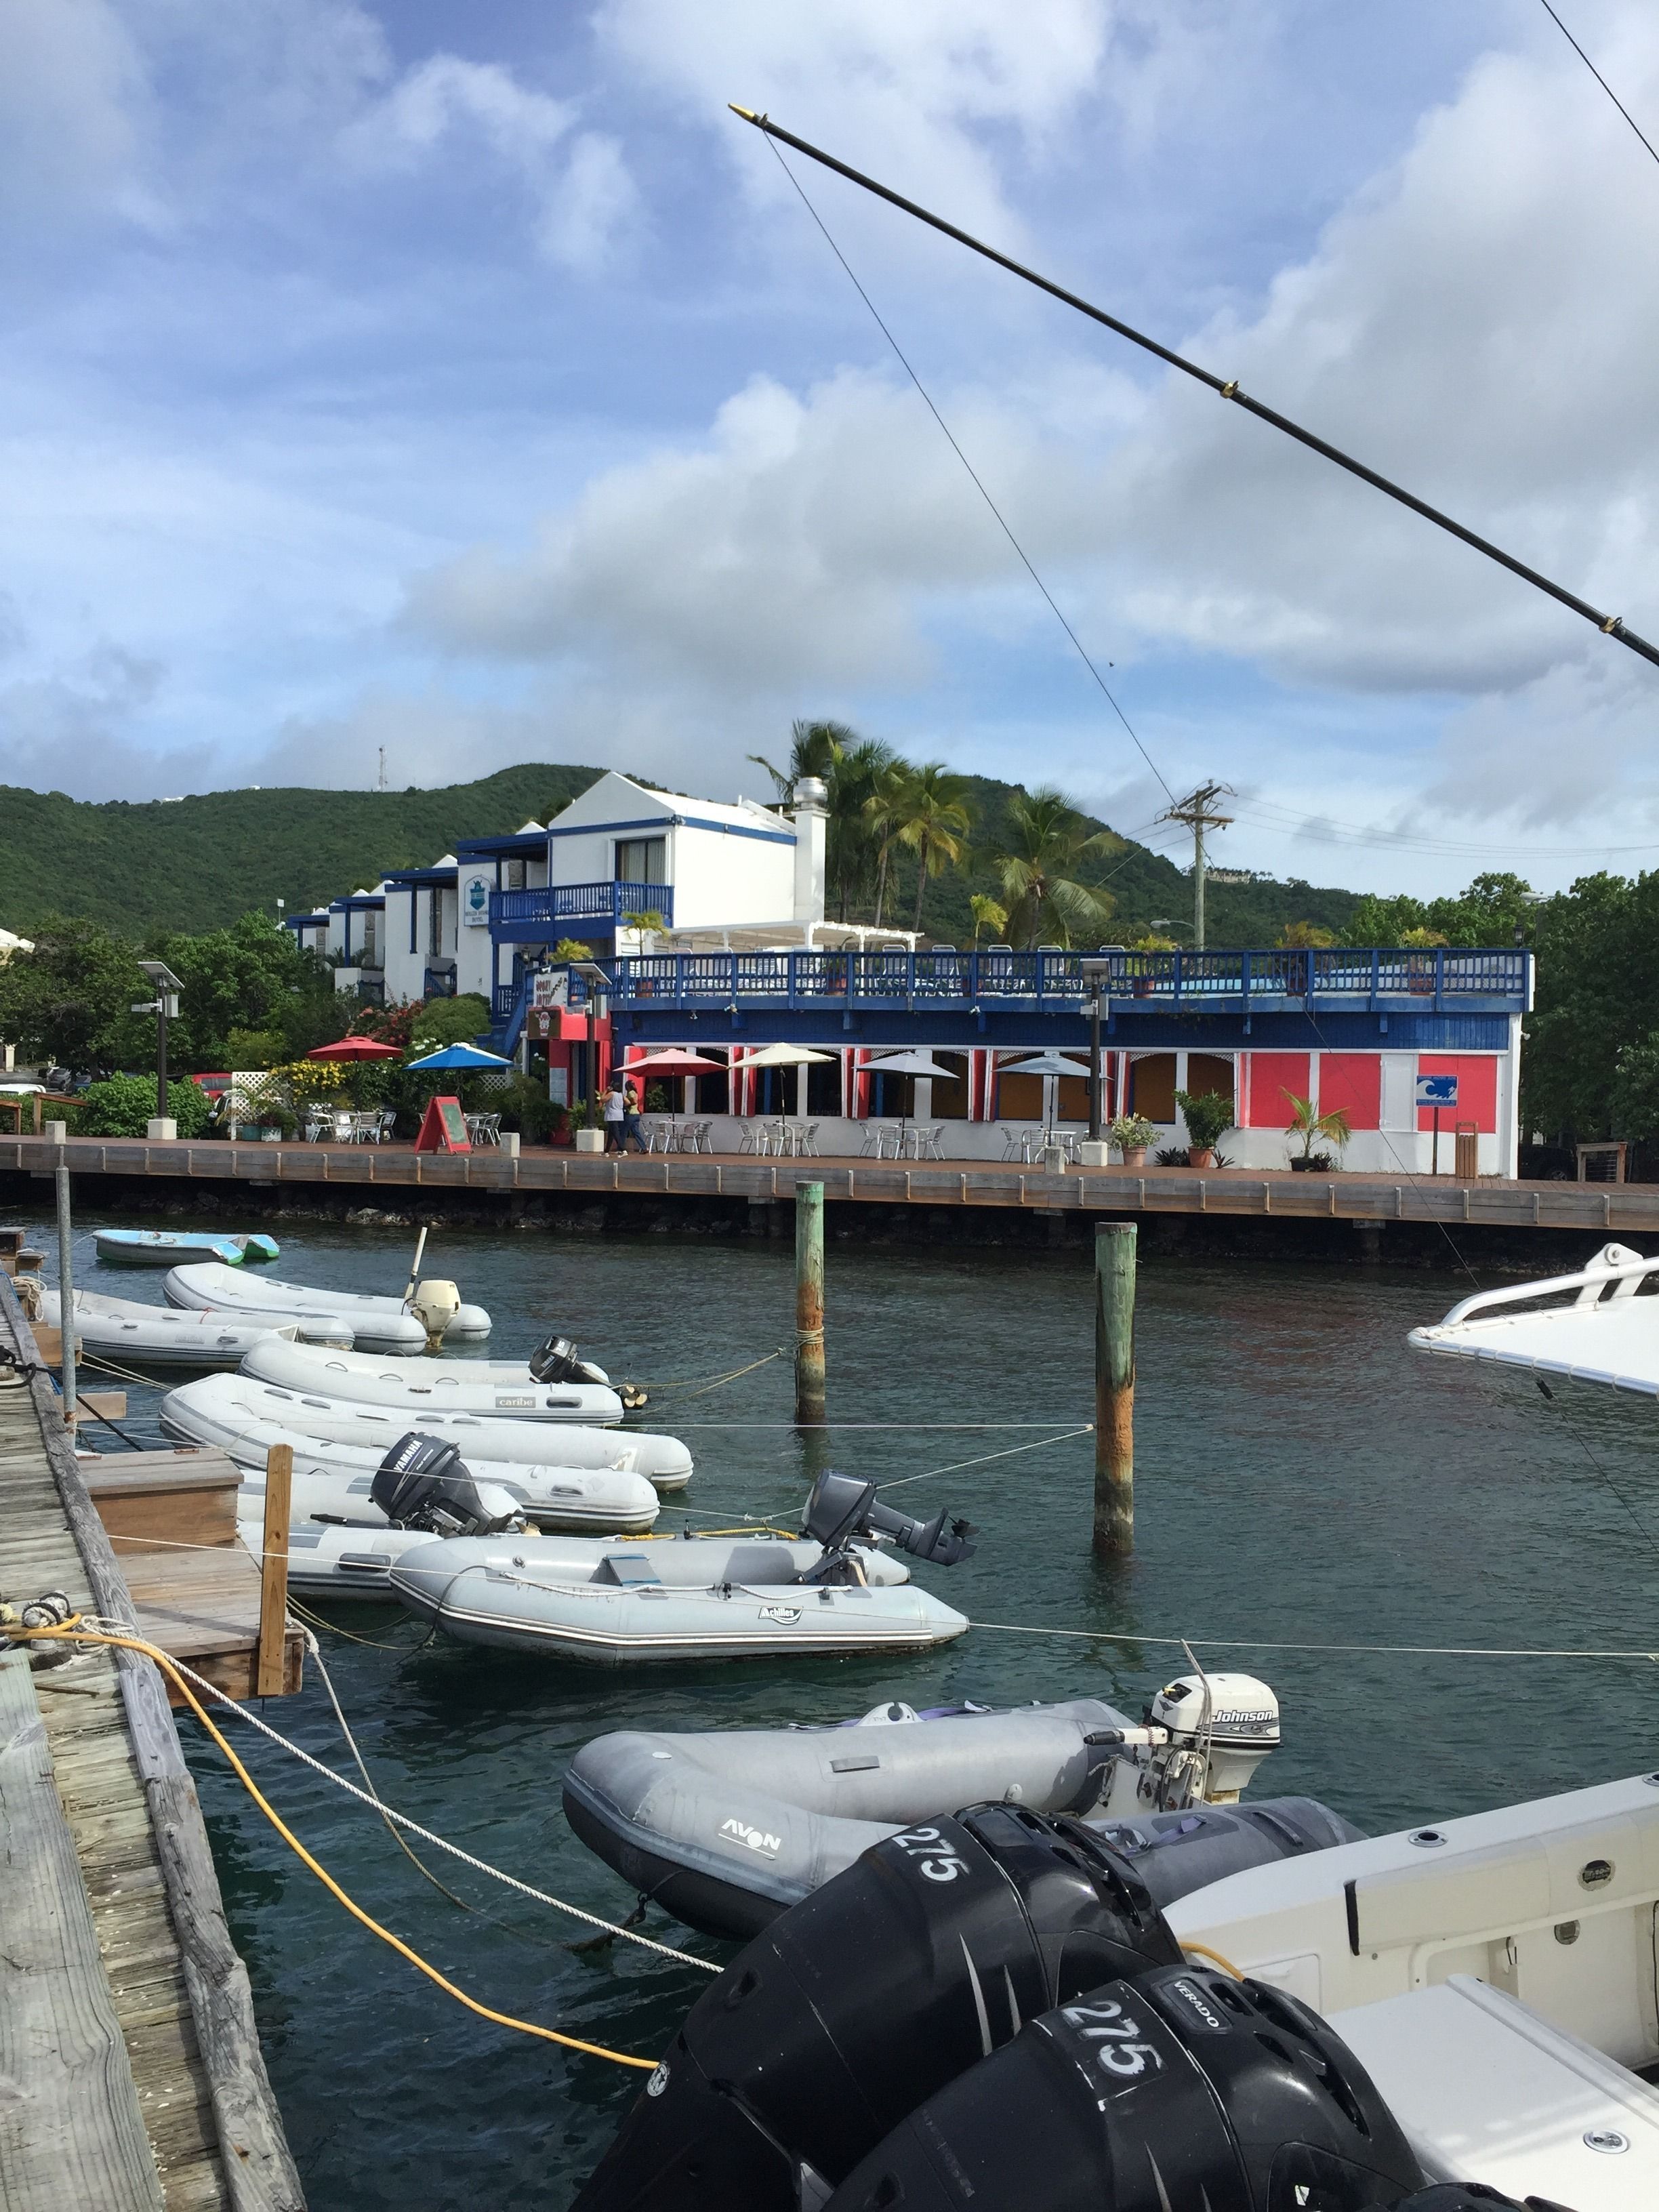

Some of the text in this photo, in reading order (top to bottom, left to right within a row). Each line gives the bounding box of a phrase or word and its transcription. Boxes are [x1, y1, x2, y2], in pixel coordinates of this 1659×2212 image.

[499, 1397, 533, 1406] caribe
[393, 1439, 423, 1471] YAMAHA
[761, 1607, 794, 1617] Achilles
[1212, 1710, 1273, 1723] Johnson
[721, 1818, 781, 1850] AVON
[891, 1827, 970, 1881] 275
[1173, 1980, 1220, 2028] VERADO
[1061, 2000, 1168, 2075] 275
